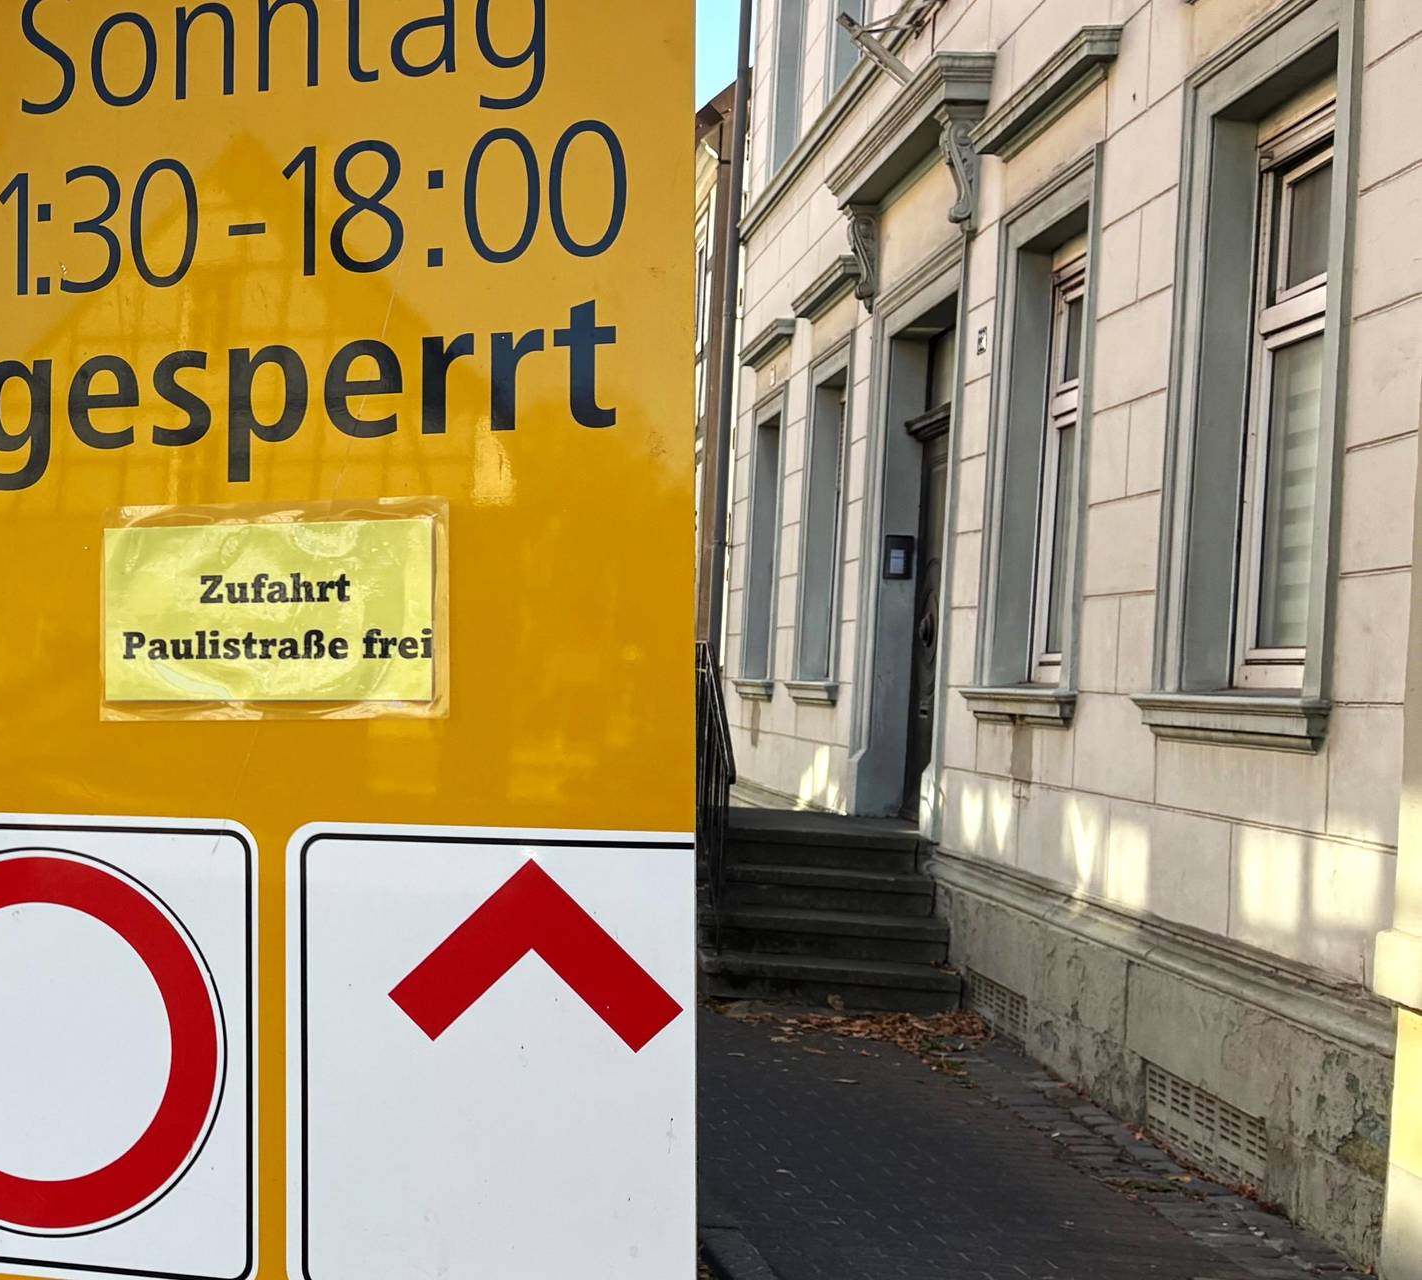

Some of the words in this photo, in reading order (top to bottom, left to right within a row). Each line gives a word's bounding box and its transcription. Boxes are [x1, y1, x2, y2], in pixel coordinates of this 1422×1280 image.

[22, 0, 545, 114] Sonntag
[282, 120, 626, 276] 18:00
[201, 573, 350, 603] Zufahrt
[124, 630, 347, 659] Paulistraße
[363, 629, 431, 658] frei
